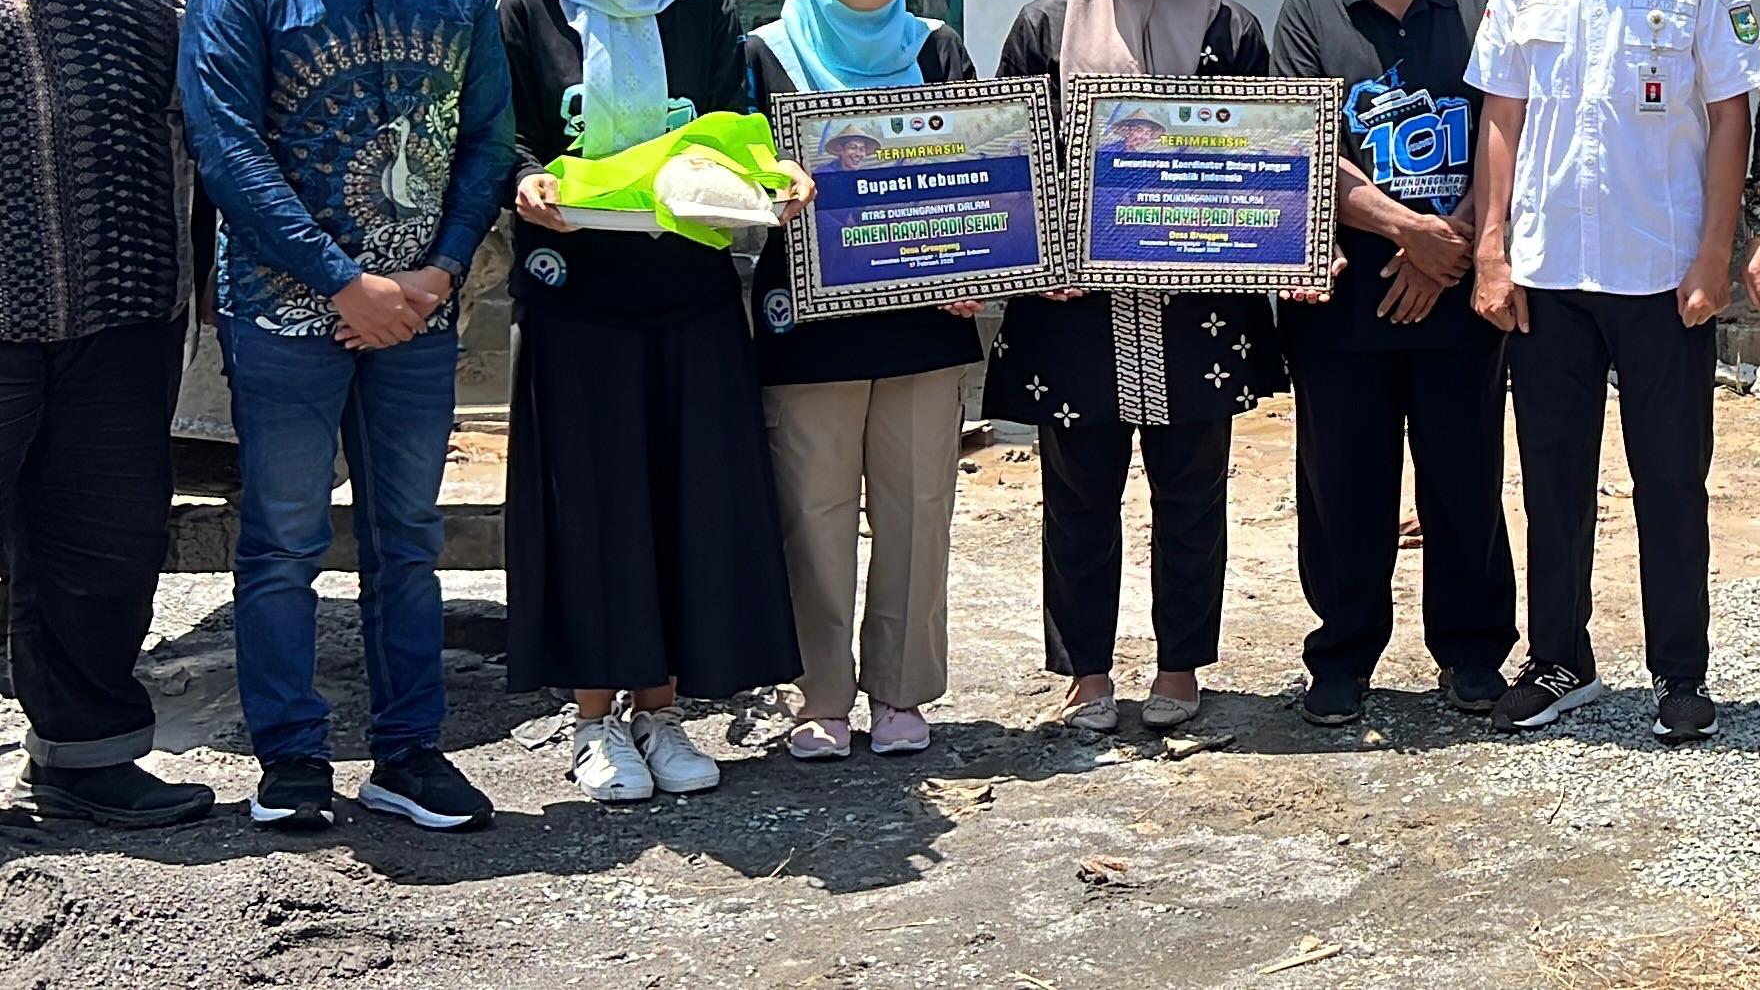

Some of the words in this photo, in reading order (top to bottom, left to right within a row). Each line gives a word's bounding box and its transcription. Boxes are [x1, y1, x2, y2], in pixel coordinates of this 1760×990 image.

[874, 142, 966, 161] TERIMAKASIH
[1160, 134, 1248, 147] TERIMAKASIH
[1360, 106, 1469, 184] 101
[857, 176, 912, 195] Bupati
[917, 170, 989, 189] Kebumen
[861, 210, 887, 222] ATAS
[957, 199, 991, 212] DALAM
[1115, 205, 1162, 225] PANEN
[1163, 206, 1201, 225] RAYA
[1202, 207, 1234, 226] PADI
[1235, 209, 1280, 227] SEHAT
[841, 223, 889, 247] PANEN
[890, 218, 930, 241] RAYA
[930, 215, 964, 238] PADI
[965, 212, 1009, 233] SEHAT
